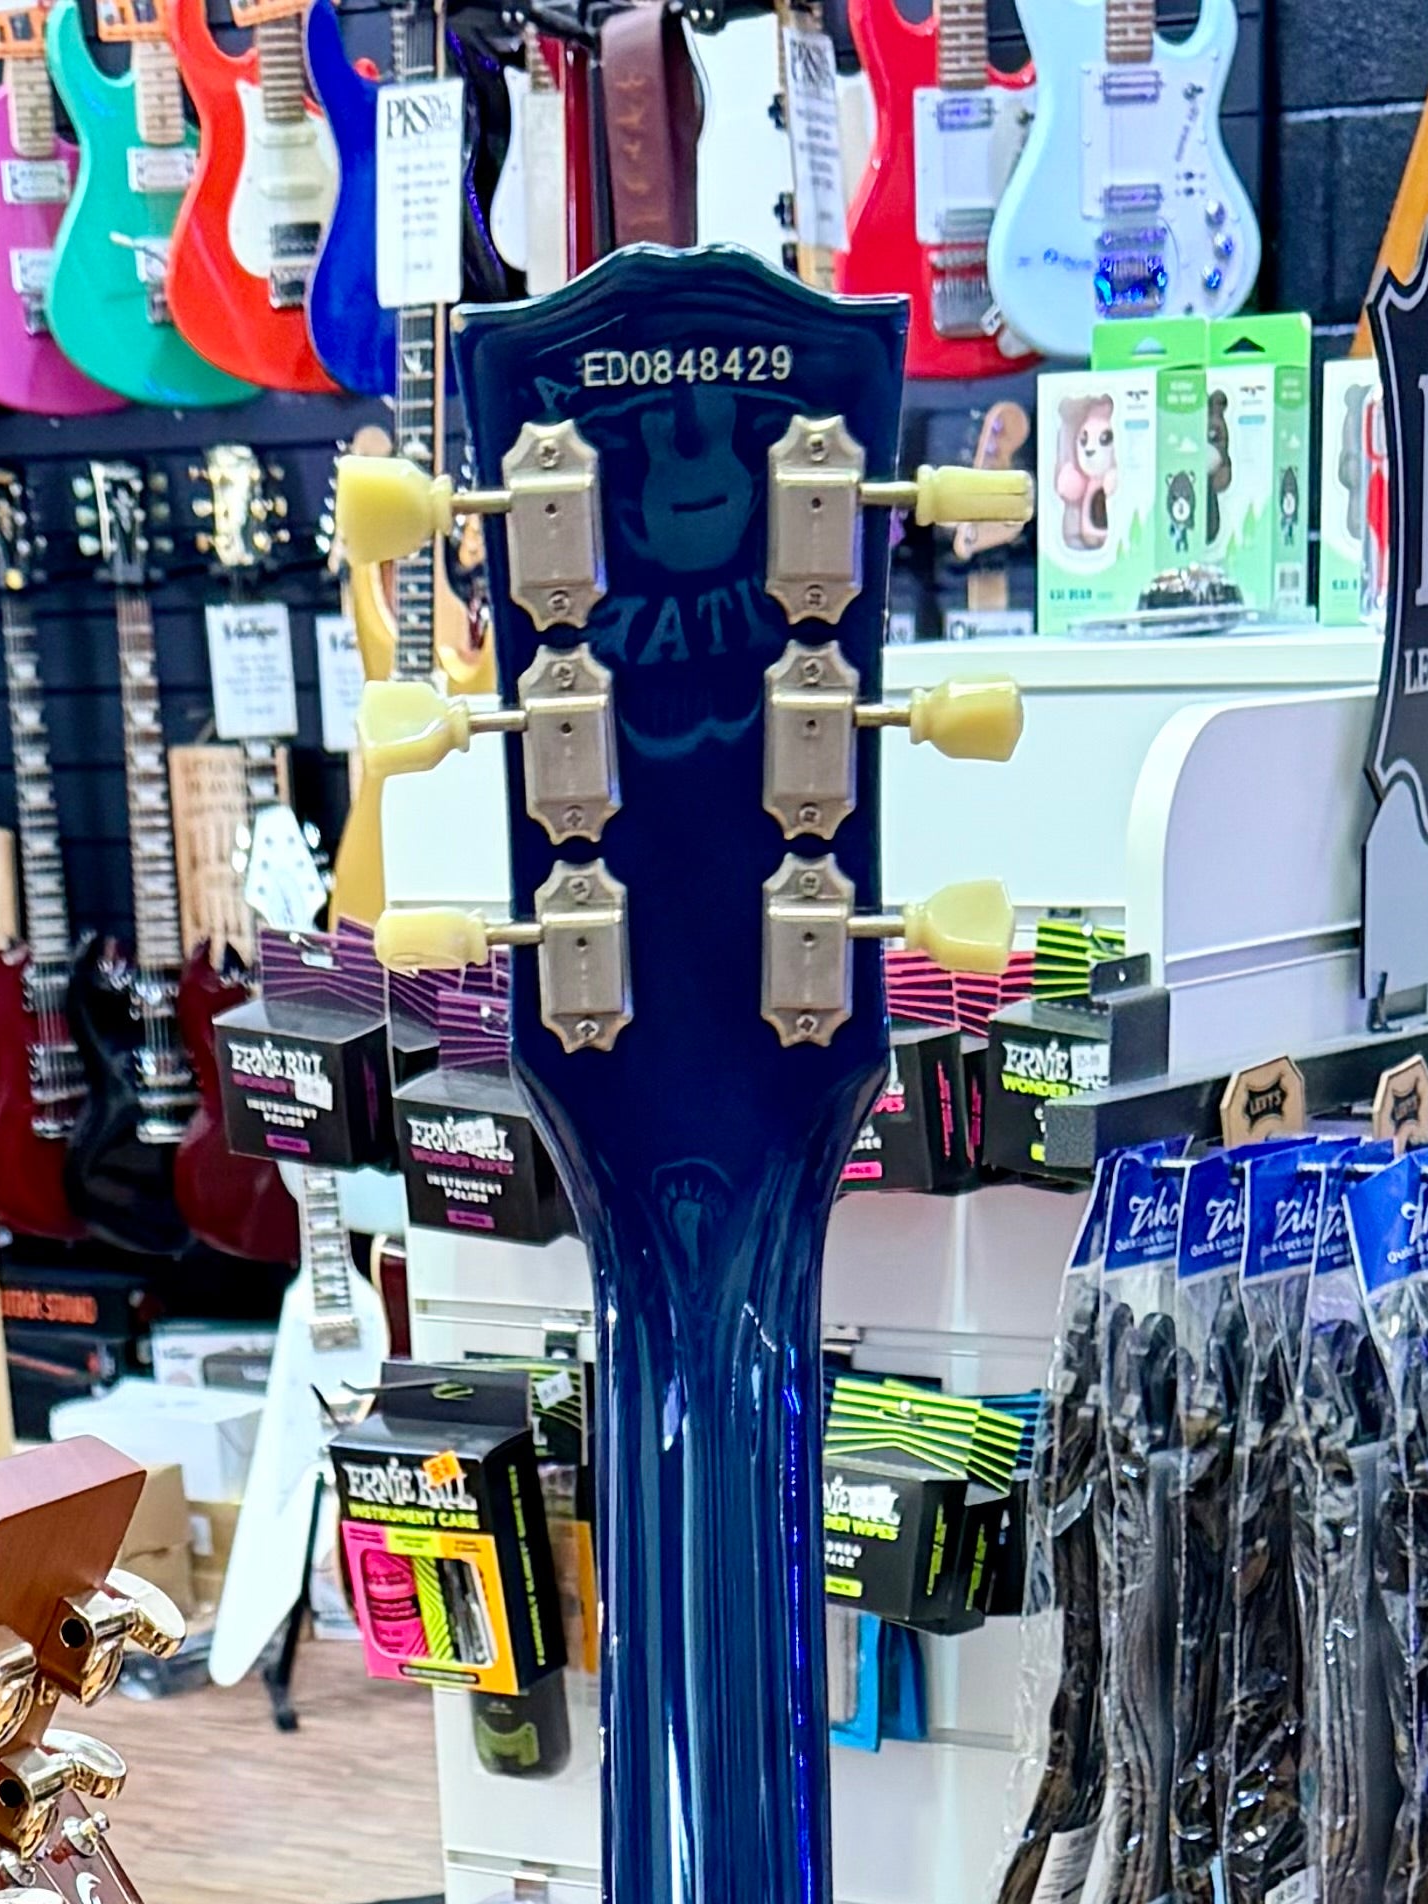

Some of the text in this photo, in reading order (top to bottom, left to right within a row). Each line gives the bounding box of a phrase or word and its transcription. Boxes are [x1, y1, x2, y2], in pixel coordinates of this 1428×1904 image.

[583, 345, 792, 387] ED0848429
[1001, 1037, 1070, 1081] ERNIE
[1001, 1073, 1070, 1098] WONDER
[341, 1456, 415, 1508] ERNIE
[348, 1502, 481, 1531] INSTRUMENT CARE
